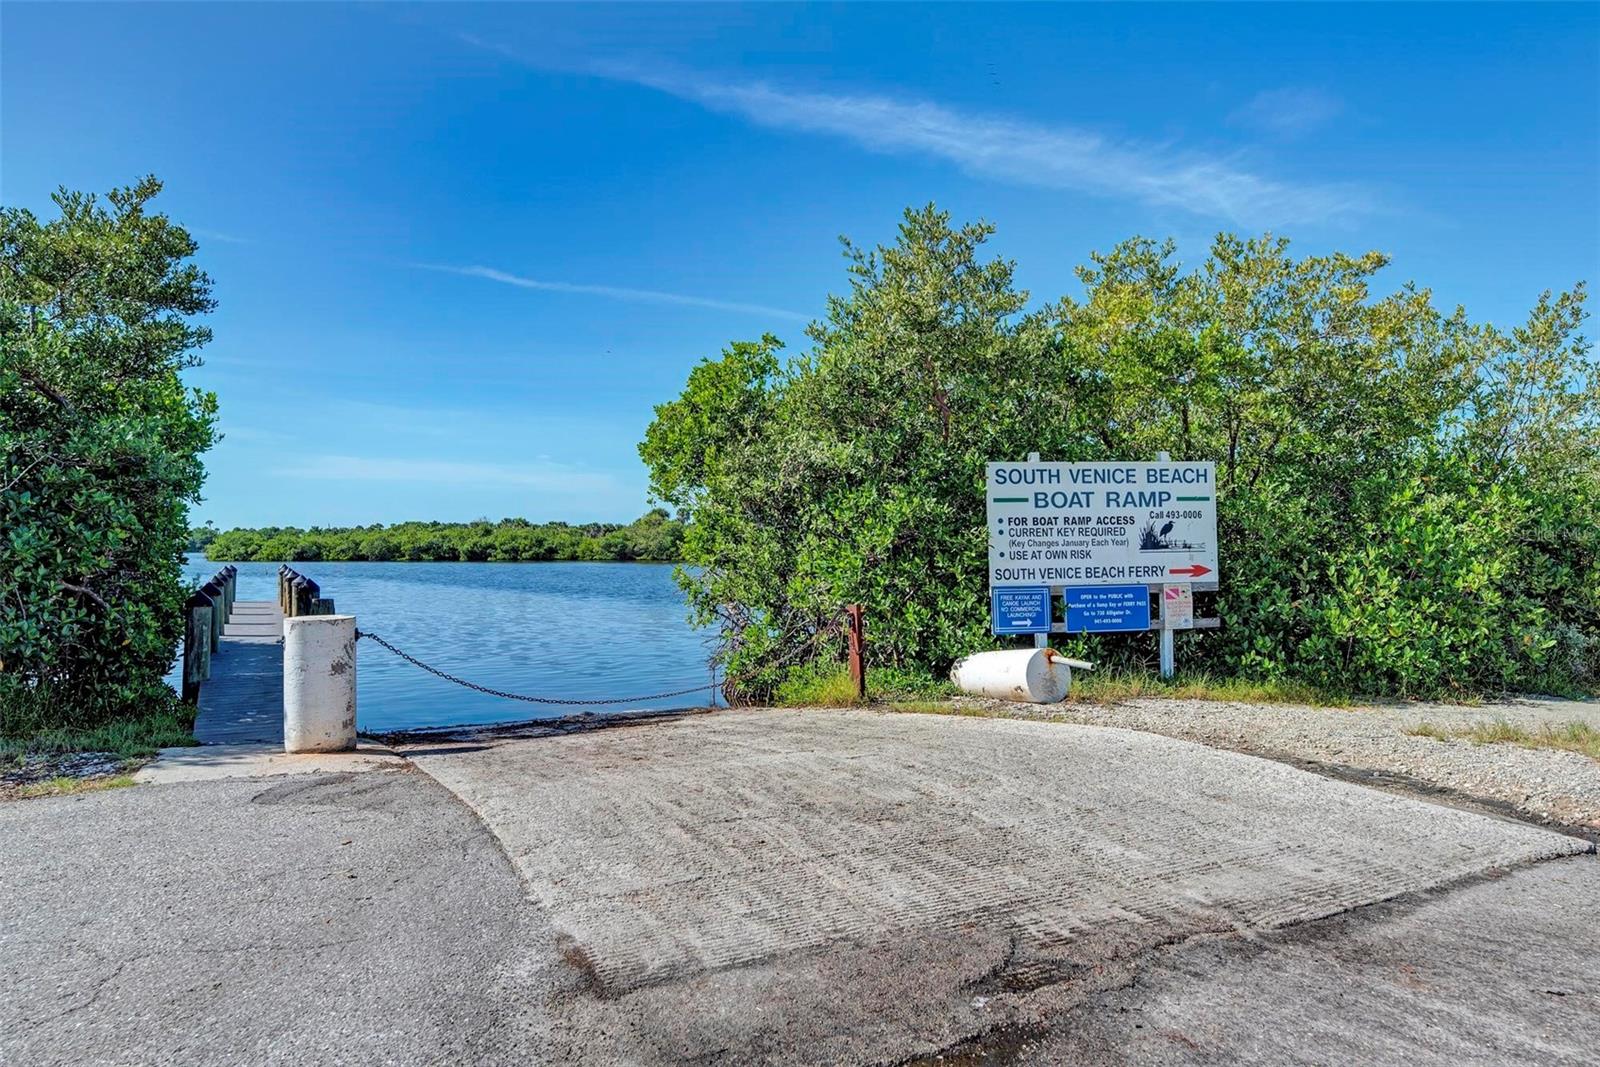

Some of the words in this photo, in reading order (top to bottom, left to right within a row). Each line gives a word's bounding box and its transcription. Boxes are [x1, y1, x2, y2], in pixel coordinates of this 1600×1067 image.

[995, 468, 1060, 484] SOUTH
[1069, 469, 1136, 483] VENICE
[1146, 468, 1208, 483] BEACH
[1034, 492, 1094, 509] BOAT
[1106, 491, 1172, 507] RAMP
[1149, 510, 1164, 519] Call
[1165, 511, 1202, 519] 493-0006
[1008, 517, 1028, 526] FOR
[1033, 517, 1060, 526] BOAT
[1064, 516, 1092, 526] RAMP
[1096, 516, 1135, 525] ACCESS
[1009, 528, 1054, 538] CURRENT
[1057, 528, 1074, 537] KEY
[1077, 527, 1126, 537] REQUIRED
[1009, 539, 1026, 549] (Key
[1027, 539, 1059, 549] Changes
[1061, 539, 1090, 549] January
[1091, 539, 1109, 547] Each
[1110, 538, 1129, 547] Year)
[1009, 551, 1029, 560] USE
[1031, 551, 1043, 560] AT
[1045, 550, 1068, 559] OWN
[1070, 550, 1092, 559] RISK
[995, 568, 1035, 581] SOUTH
[1039, 568, 1082, 580] VENICE
[1085, 567, 1125, 579] BEACH
[1129, 566, 1165, 577] FERRY
